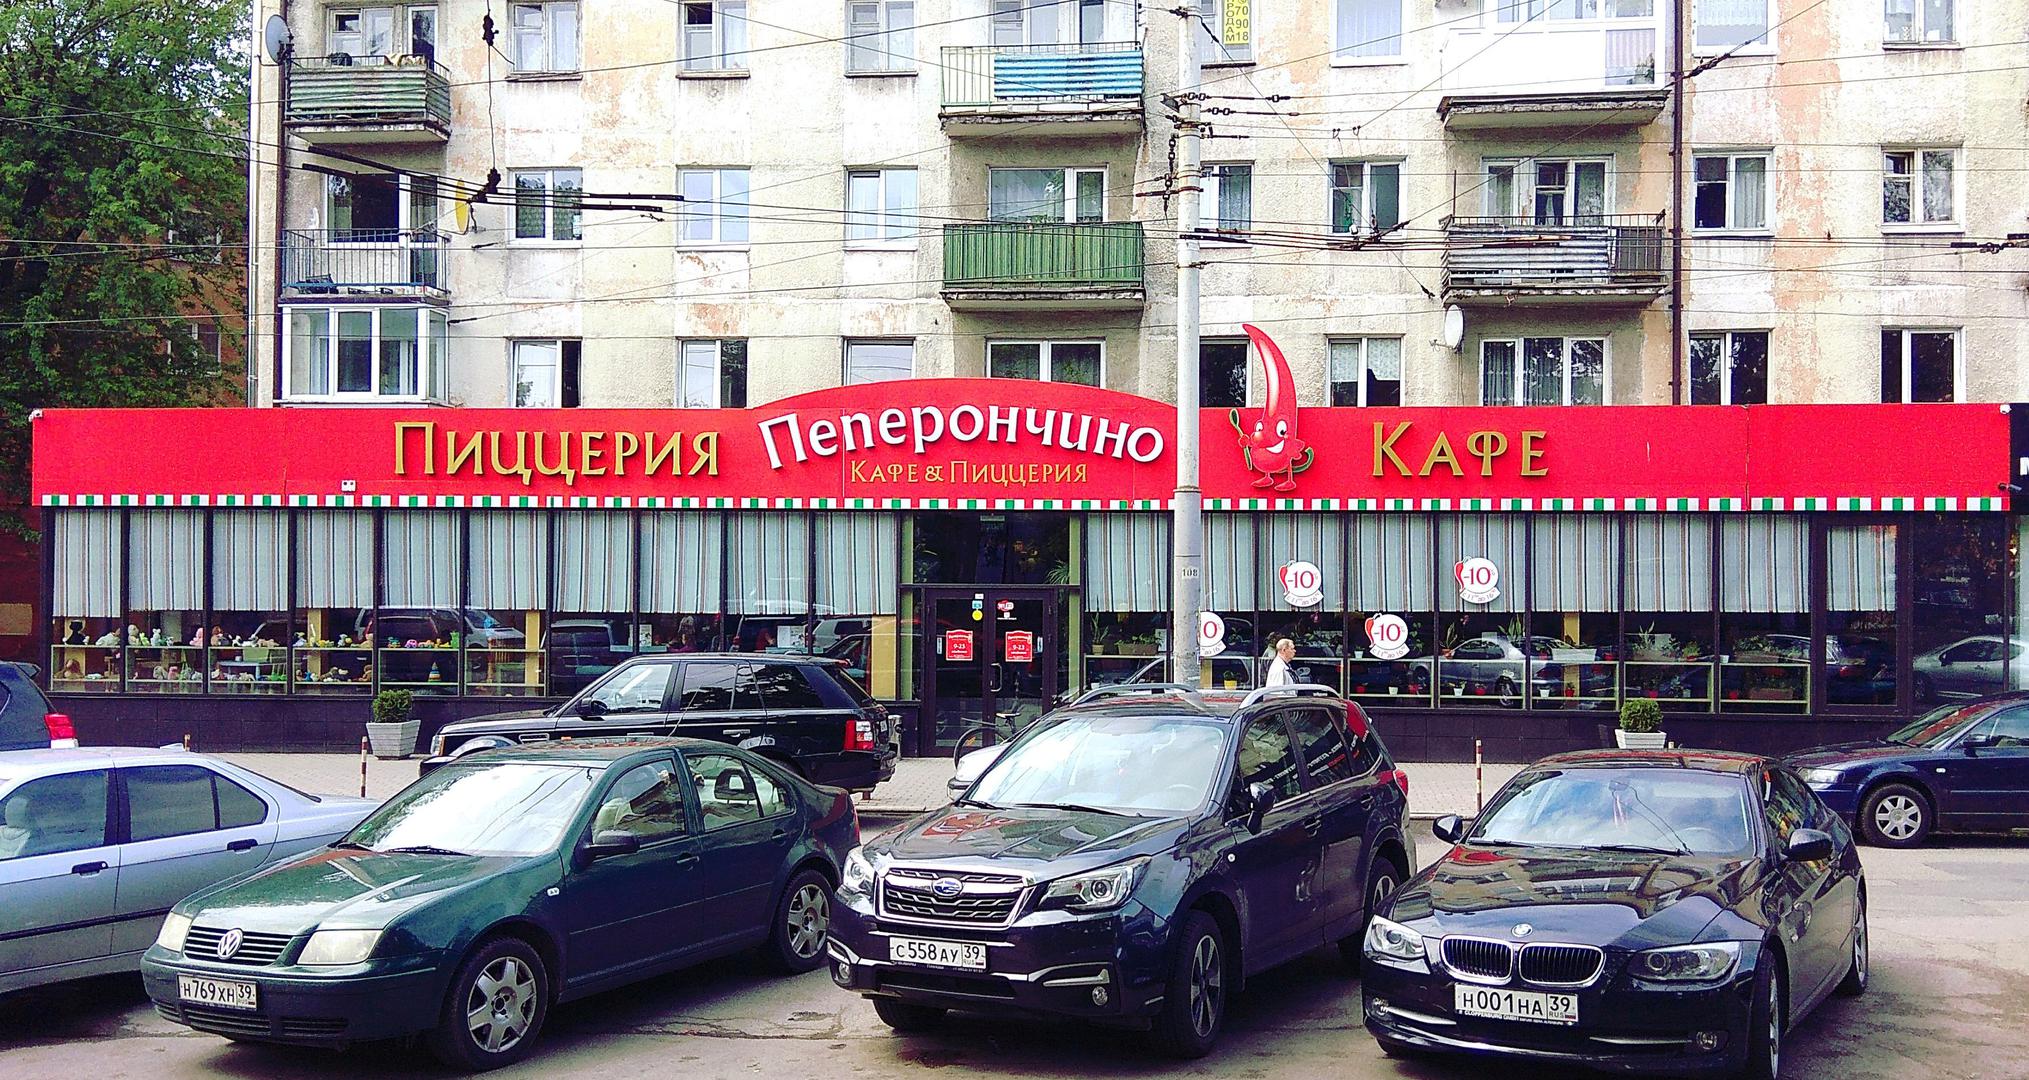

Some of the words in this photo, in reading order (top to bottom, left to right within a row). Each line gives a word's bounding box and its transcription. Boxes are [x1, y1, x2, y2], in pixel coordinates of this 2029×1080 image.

[1235, 5, 1249, 16] 70
[1235, 18, 1249, 29] 90
[1236, 31, 1249, 42] 18
[757, 404, 1164, 470] Пеперончино
[924, 465, 944, 482] &
[964, 944, 980, 960] 39
[238, 984, 252, 999] 39
[1549, 995, 1571, 1013] 39
[1548, 1011, 1565, 1019] RUS
